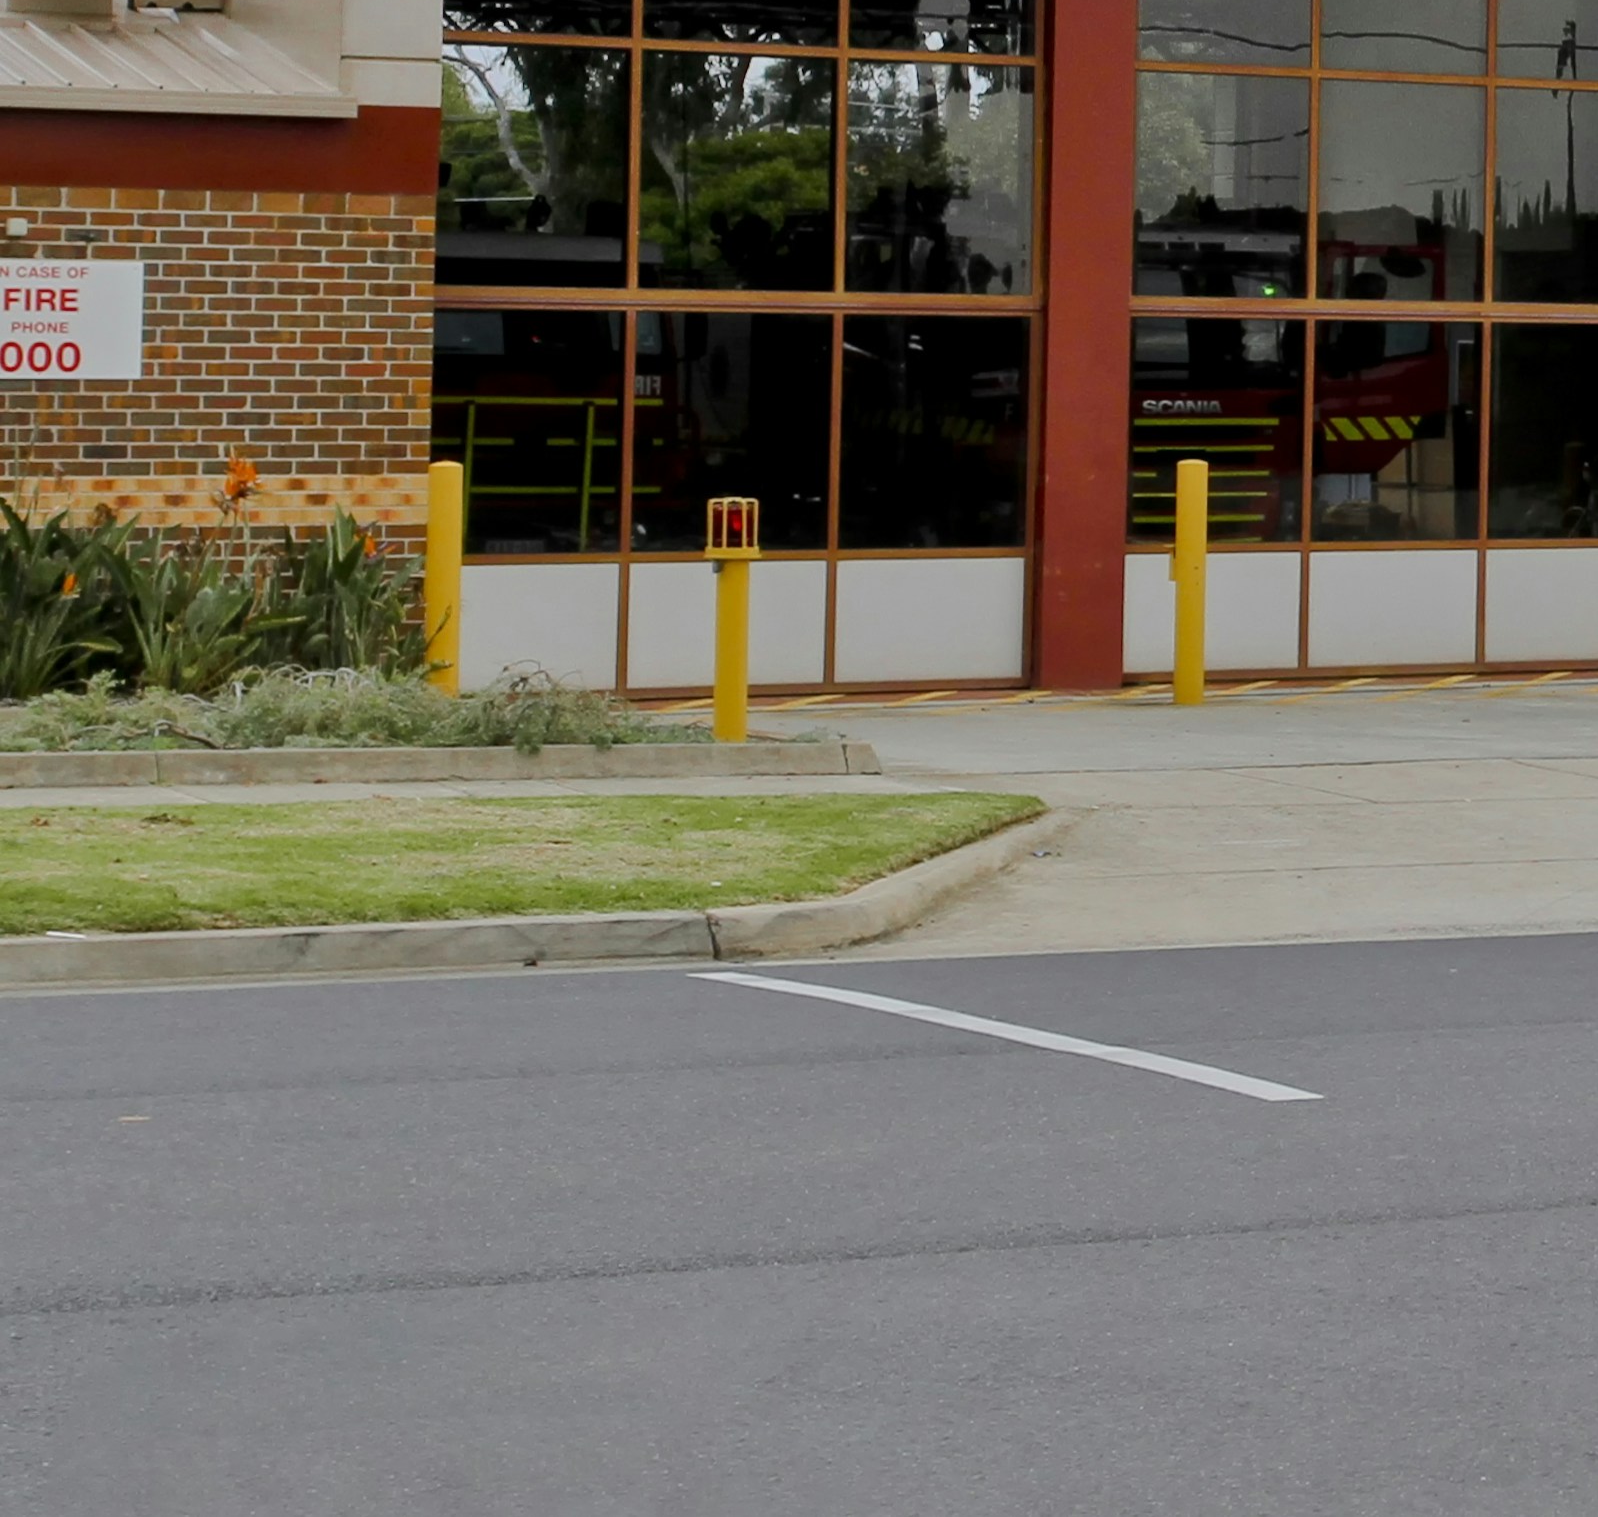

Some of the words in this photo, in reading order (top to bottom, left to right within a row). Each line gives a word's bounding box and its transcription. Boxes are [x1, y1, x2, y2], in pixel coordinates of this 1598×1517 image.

[16, 267, 60, 278] CASE
[67, 267, 89, 279] OF
[4, 288, 79, 312] FIRE
[11, 322, 69, 333] PHONE
[0, 341, 81, 373] 000
[1142, 399, 1222, 414] SCANIA
